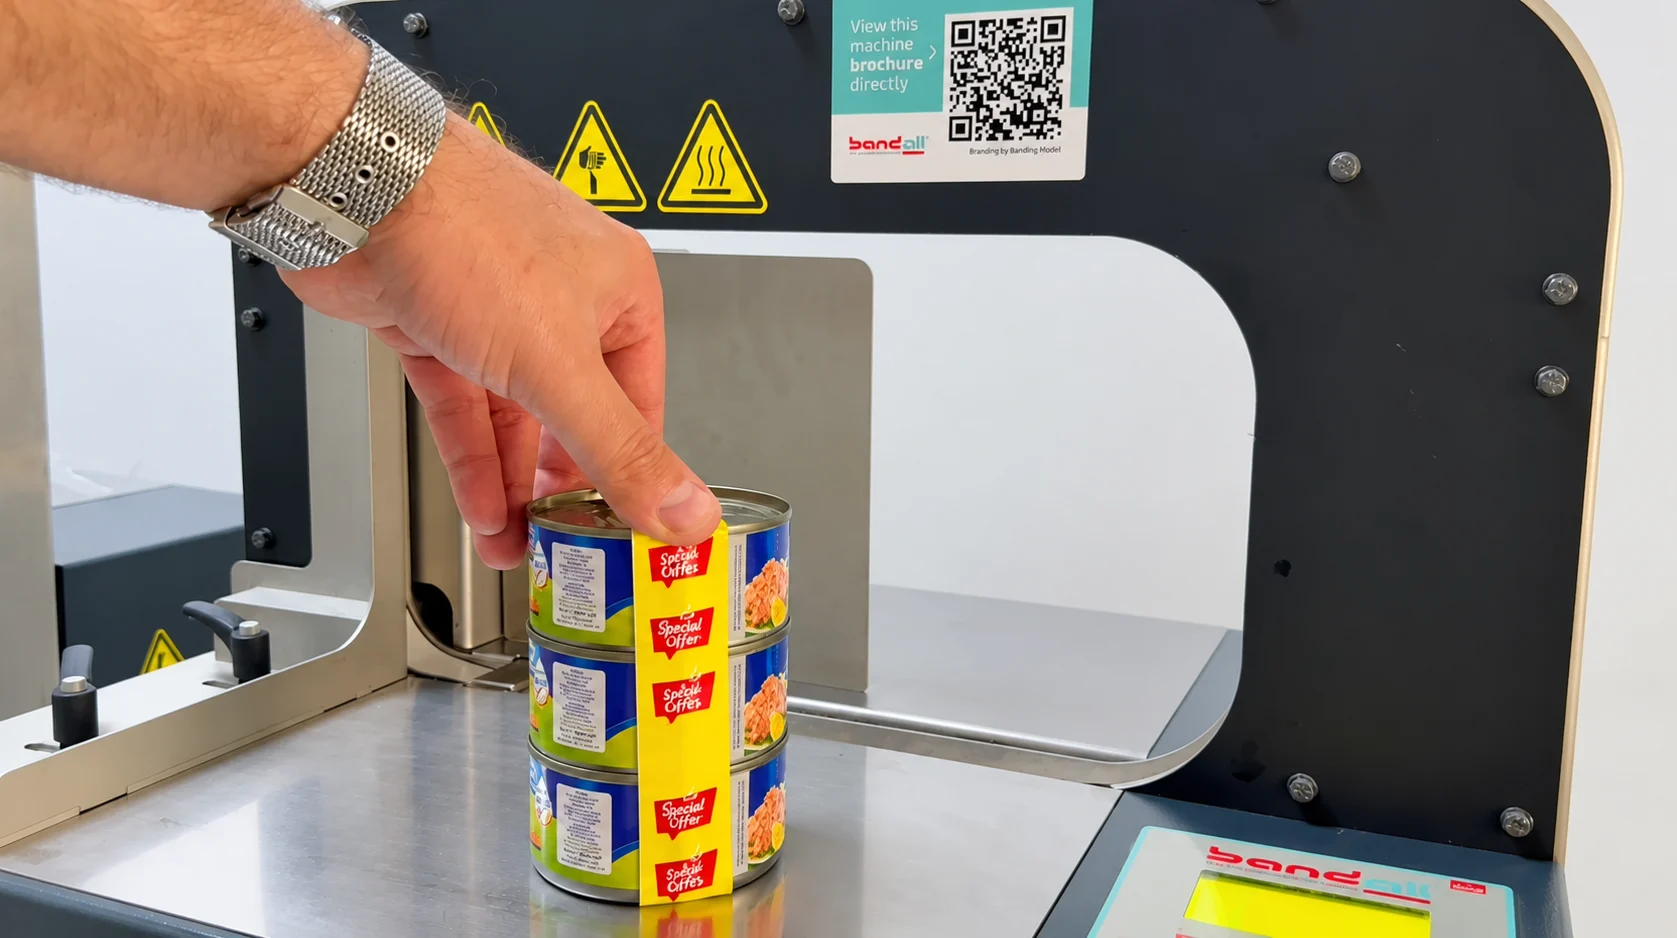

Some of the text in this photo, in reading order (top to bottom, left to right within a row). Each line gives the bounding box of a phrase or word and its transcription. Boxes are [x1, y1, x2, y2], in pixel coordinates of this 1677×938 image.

[851, 17, 918, 33] View this
[850, 37, 913, 52] machine
[850, 56, 923, 72] brochure
[850, 76, 909, 93] directly
[849, 135, 925, 151] bandall
[969, 145, 1061, 156] Branding by Banding Model
[657, 617, 703, 639] Special
[666, 633, 702, 649] Offer
[662, 797, 705, 821] Special
[669, 813, 704, 830] Offer
